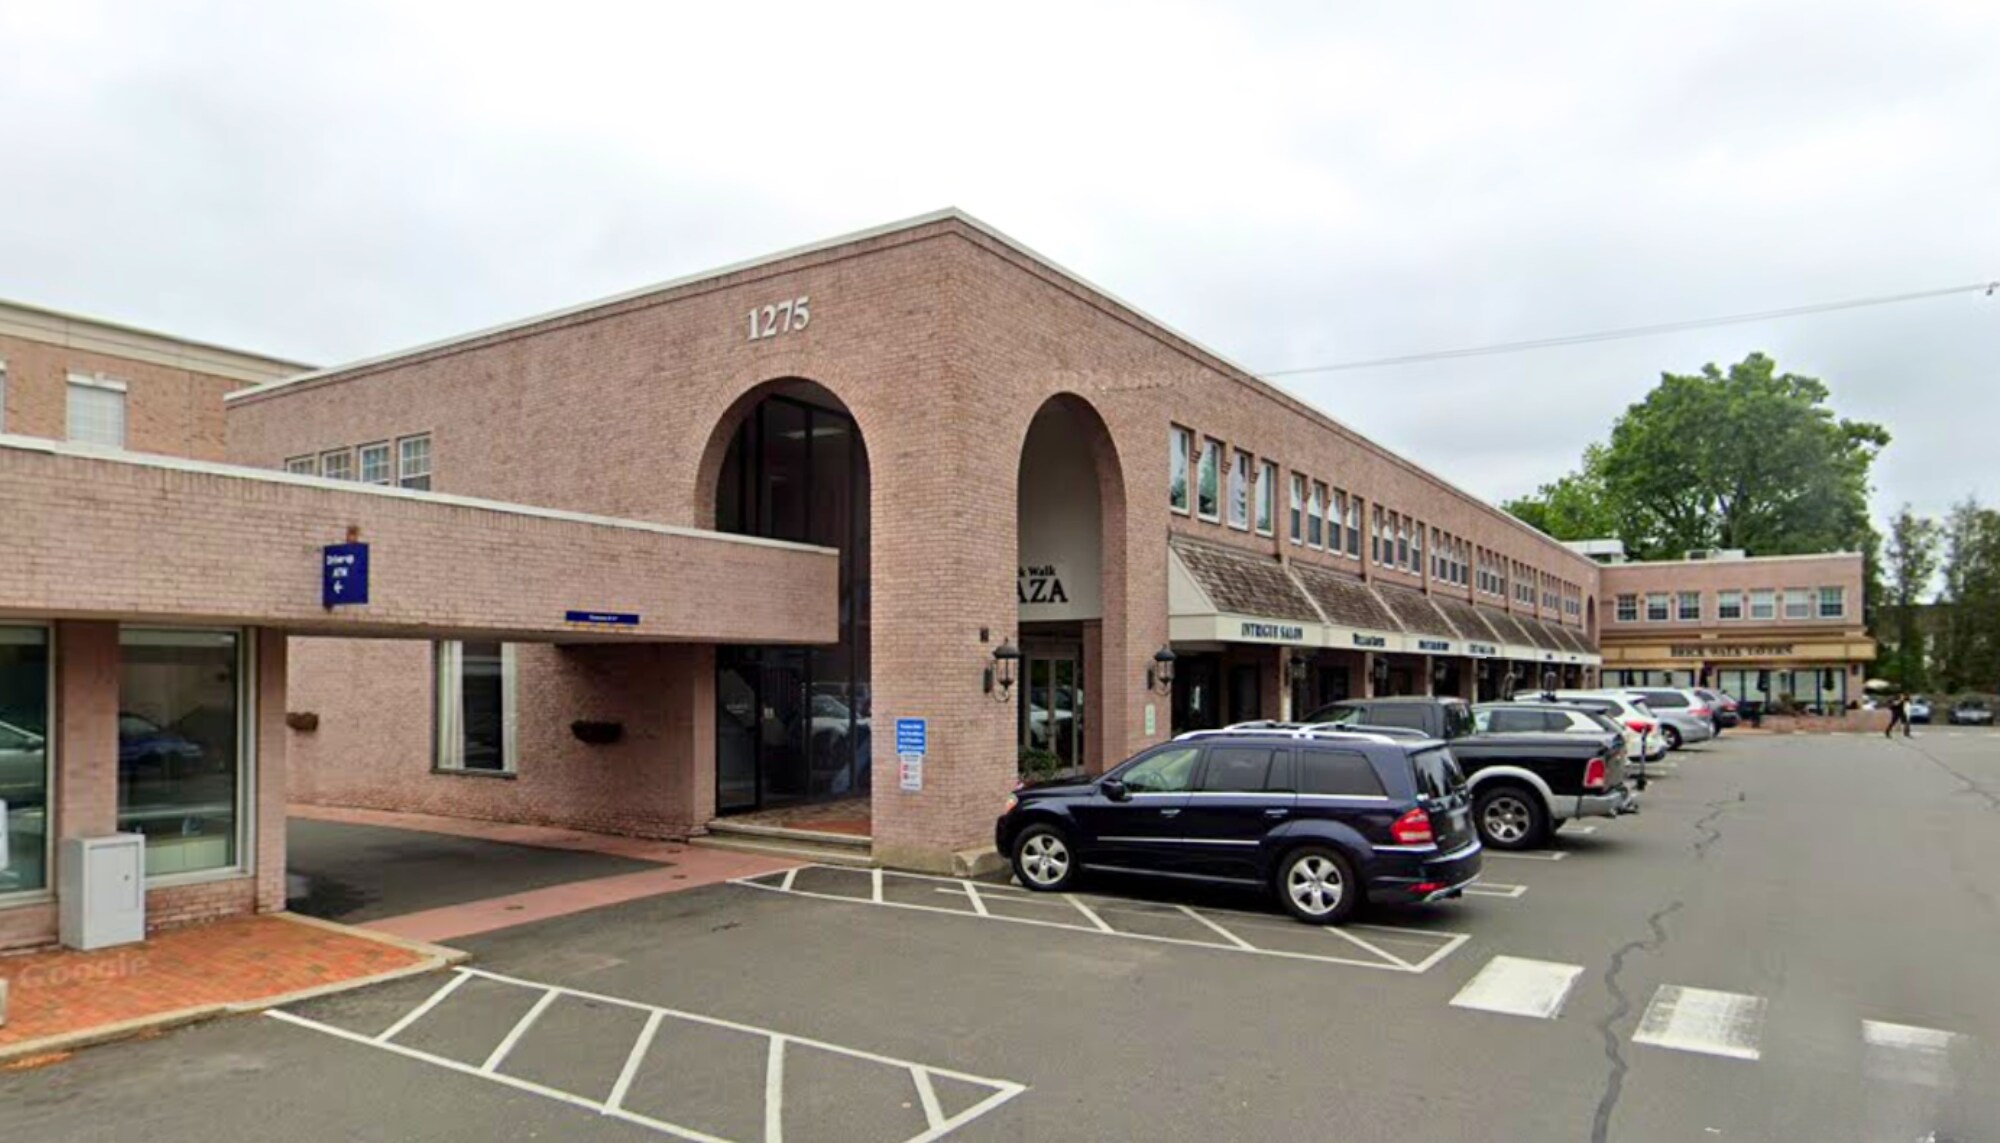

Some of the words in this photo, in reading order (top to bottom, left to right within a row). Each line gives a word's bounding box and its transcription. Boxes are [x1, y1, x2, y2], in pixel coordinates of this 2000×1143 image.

[747, 296, 810, 341] 1275
[1028, 564, 1056, 577] Walk
[1280, 625, 1304, 640] SALON
